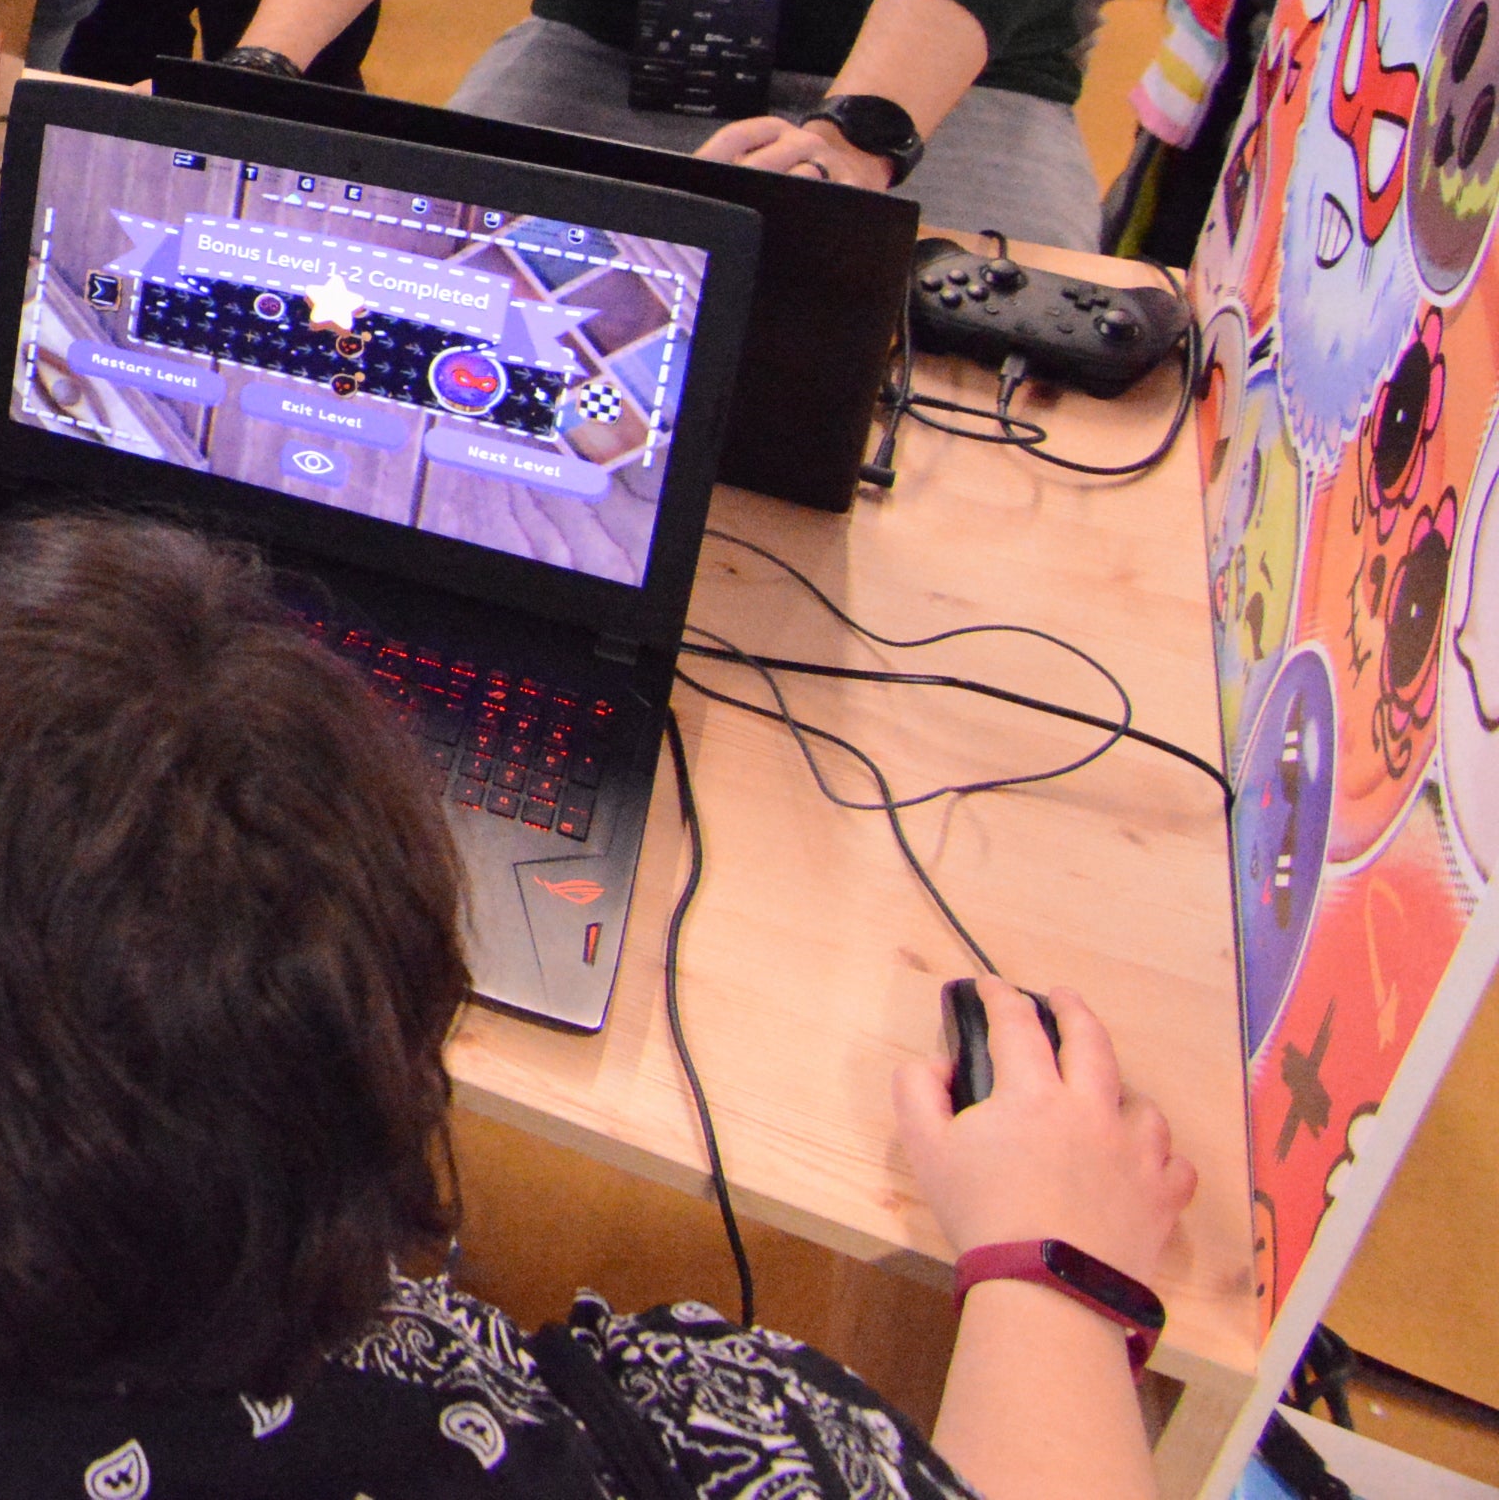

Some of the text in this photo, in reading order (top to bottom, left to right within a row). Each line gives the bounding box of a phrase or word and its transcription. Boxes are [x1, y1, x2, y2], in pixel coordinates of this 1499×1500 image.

[198, 234, 490, 311] Bonus Level 1-2 Completed
[91, 353, 198, 388] Restart Level
[281, 399, 363, 429] Exit Level
[467, 445, 562, 478] Next Level
